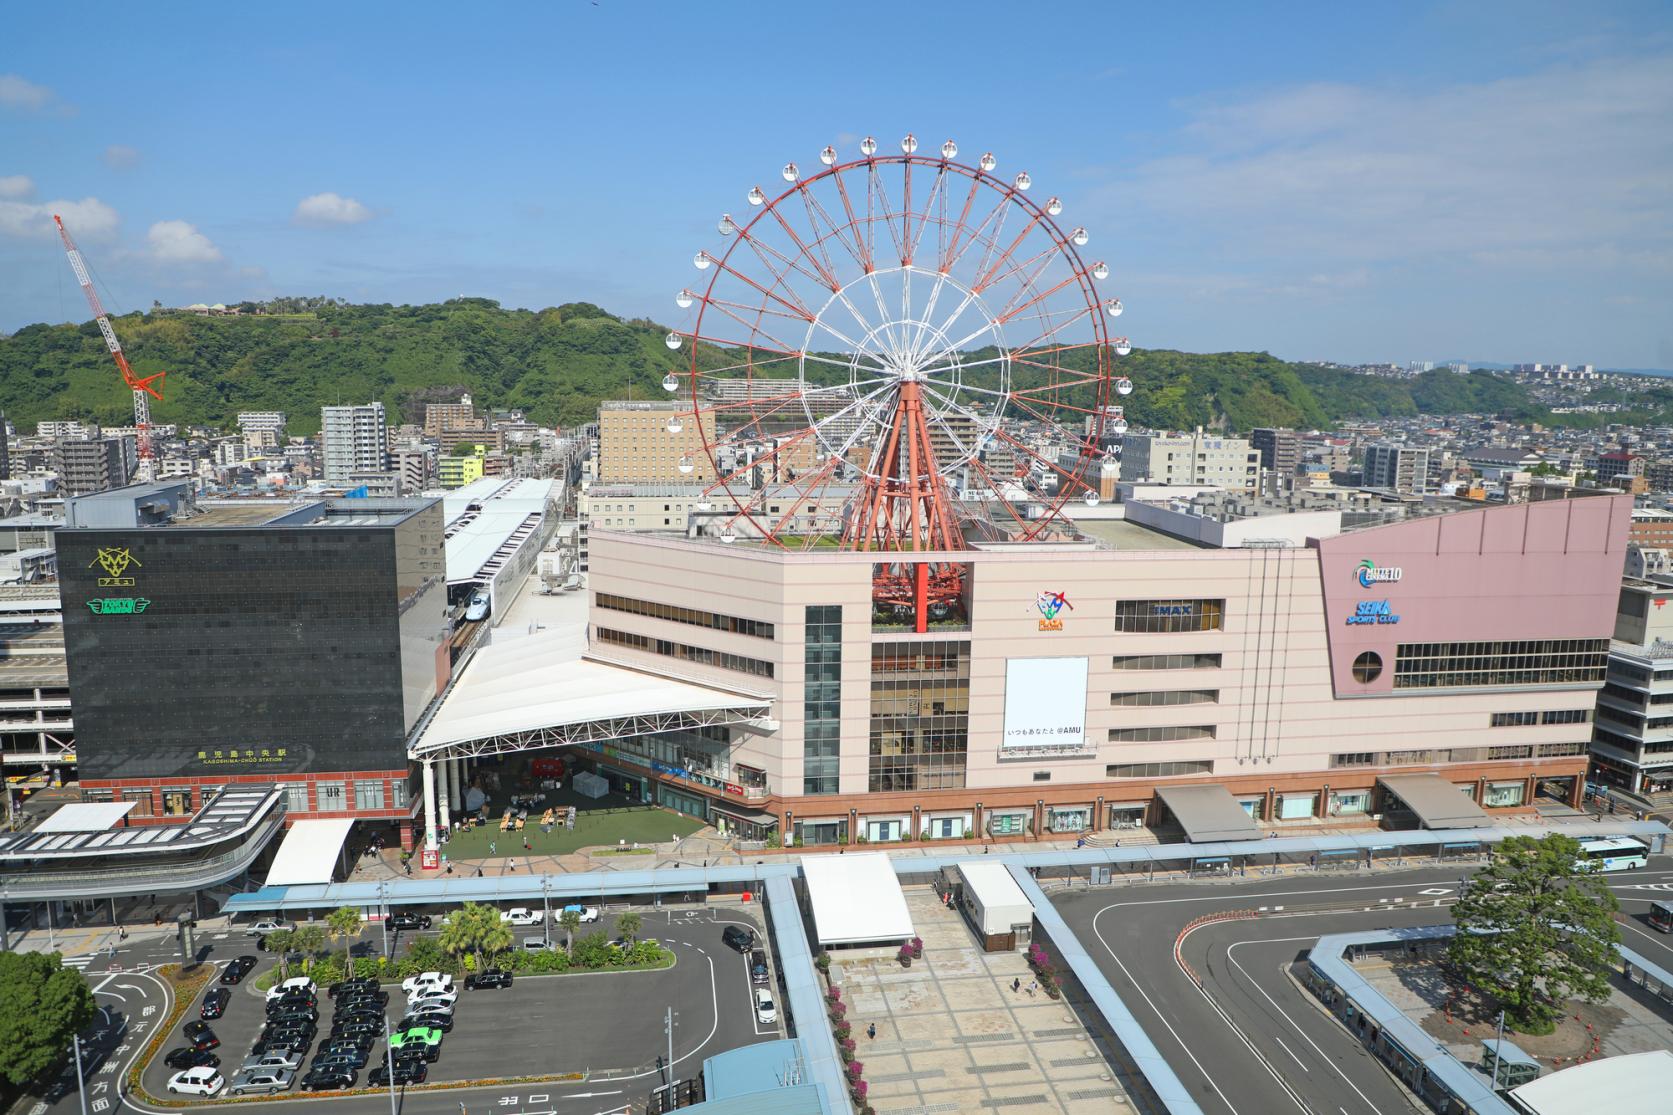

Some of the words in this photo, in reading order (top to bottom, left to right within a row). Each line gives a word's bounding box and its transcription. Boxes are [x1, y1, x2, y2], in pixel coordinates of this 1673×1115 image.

[1357, 599, 1391, 616] SEIKA
[1007, 727, 1055, 736] いつもあなたと
[1056, 726, 1081, 735] @AMU
[198, 748, 287, 759] 鹿児島中央駅
